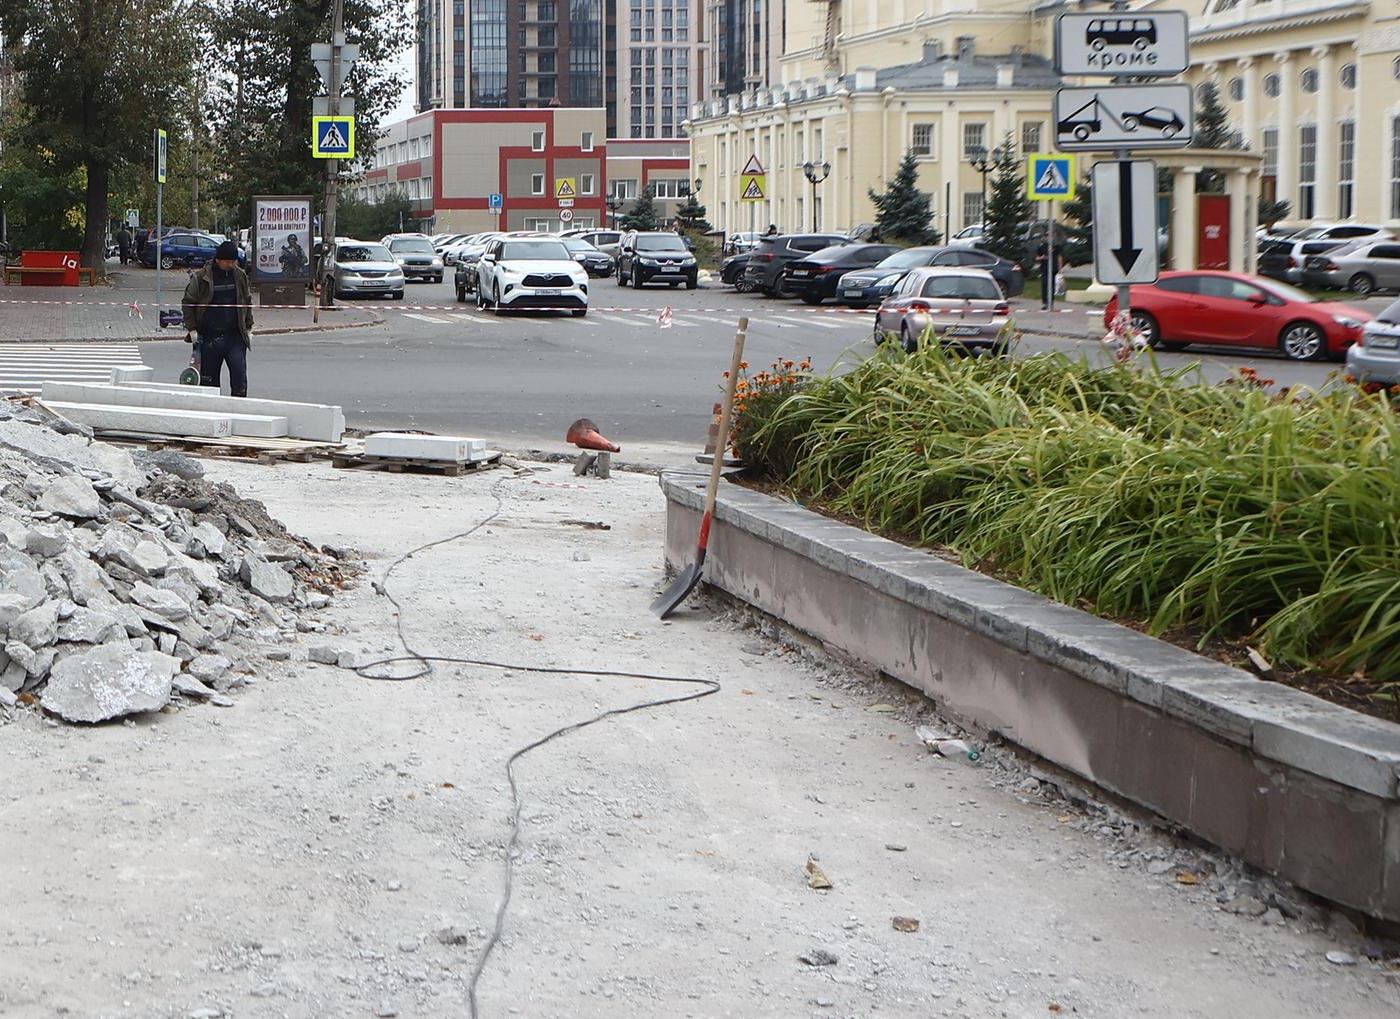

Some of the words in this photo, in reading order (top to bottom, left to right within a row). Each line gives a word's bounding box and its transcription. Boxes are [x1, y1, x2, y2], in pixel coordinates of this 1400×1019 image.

[1087, 52, 1158, 70] кроме
[260, 208, 265, 221] 2
[267, 208, 281, 221] 000
[284, 208, 299, 221] 000
[561, 211, 571, 219] 40
[62, 255, 77, 269] la
